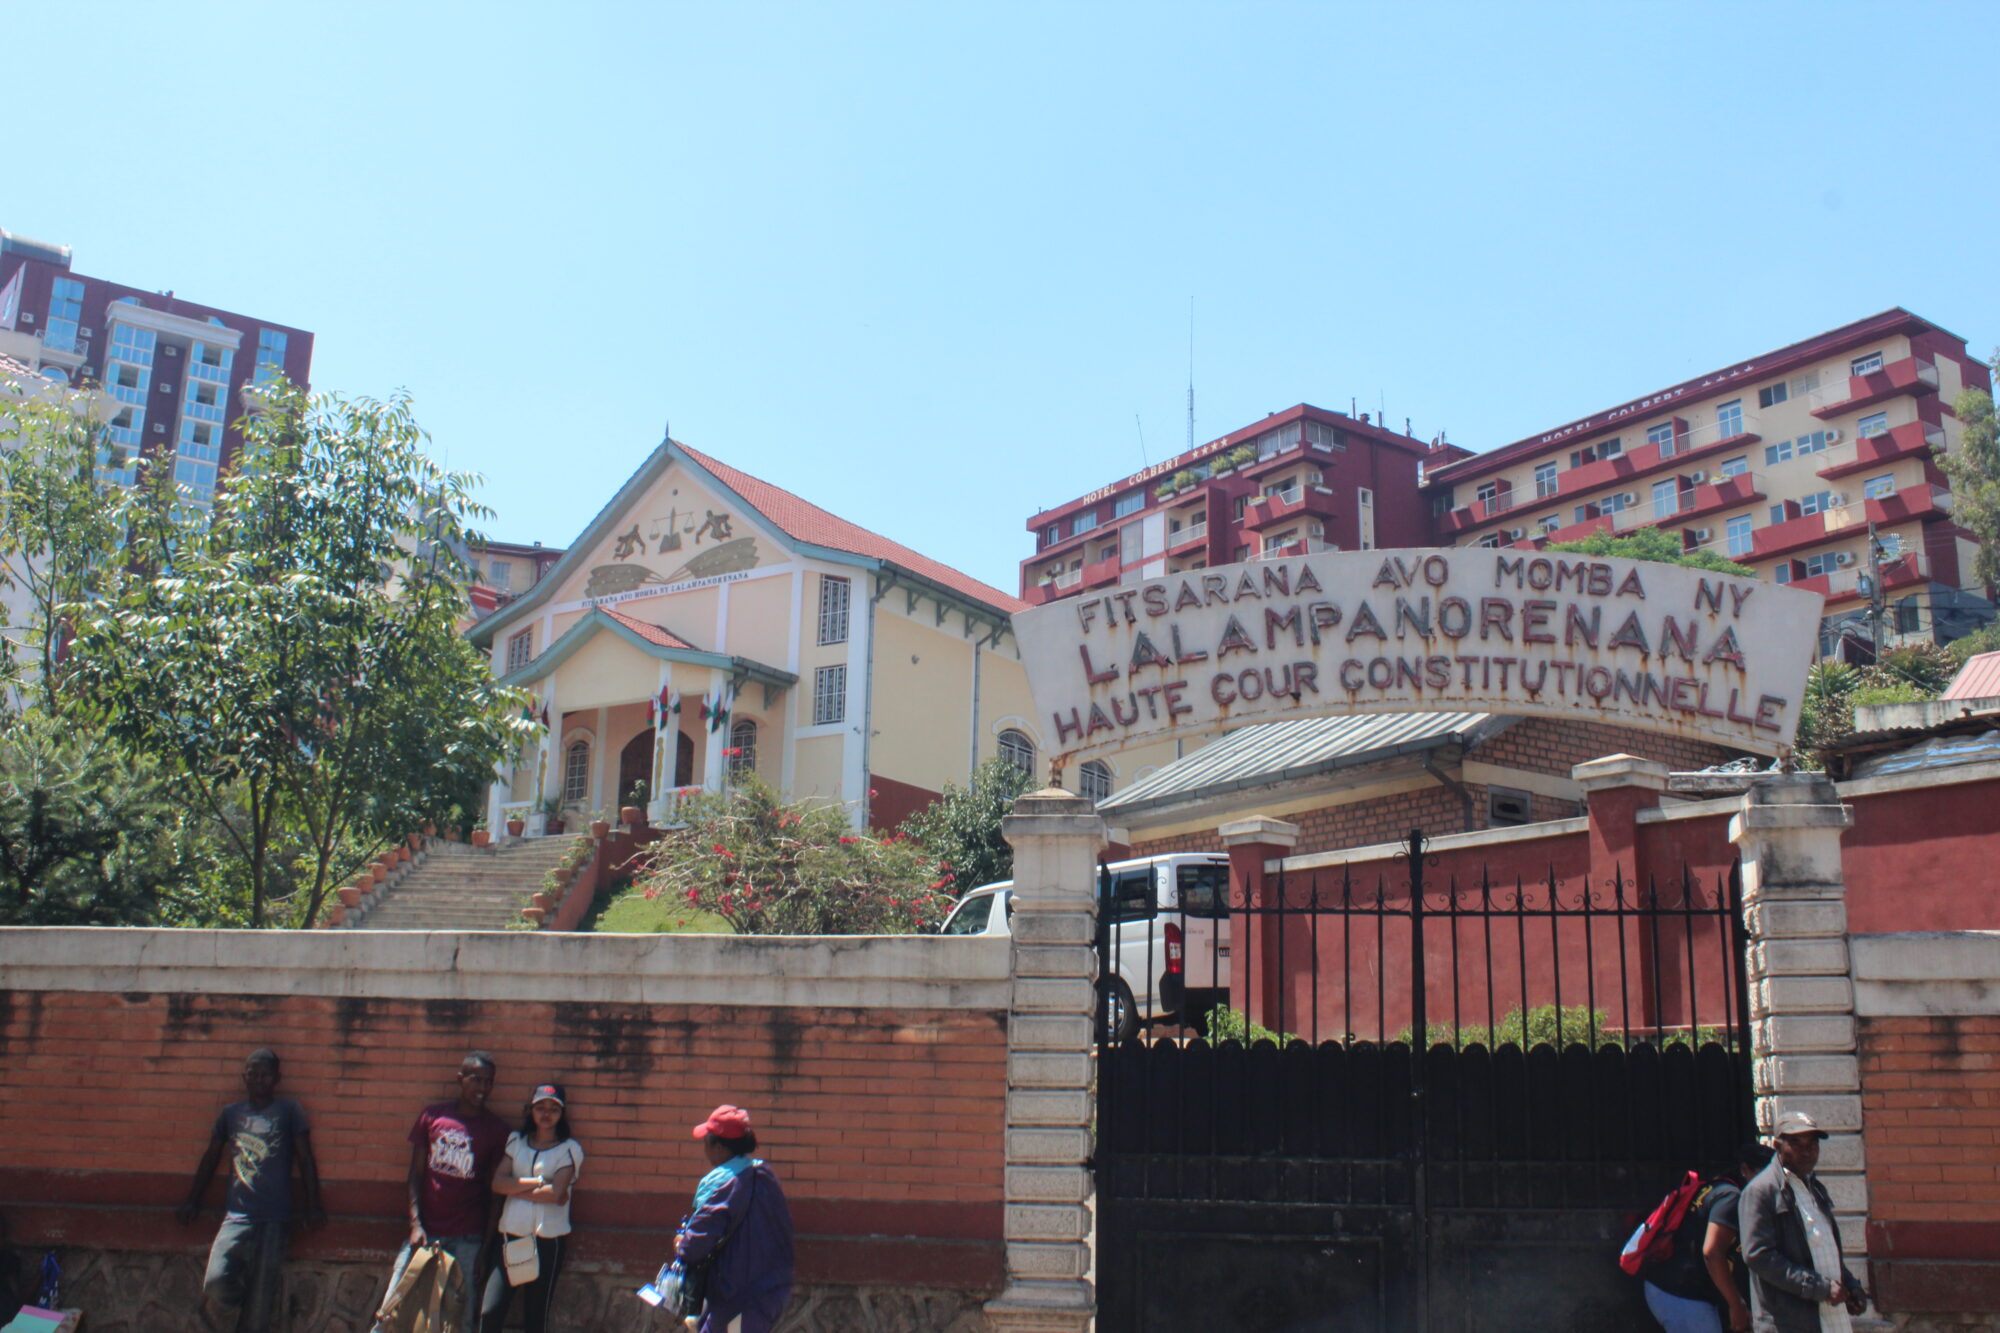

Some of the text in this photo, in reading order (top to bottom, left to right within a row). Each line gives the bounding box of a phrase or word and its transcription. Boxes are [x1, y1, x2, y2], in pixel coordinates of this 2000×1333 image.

[1083, 456, 1180, 506] HOTEL COLBERT
[582, 596, 618, 607] FITARANA
[1076, 554, 1754, 633] FITSARANA AVO MOMBA NY
[1079, 596, 1746, 686] LALAMPANORENANA
[1053, 655, 1787, 745] HAUTE COUR CONSTITUTIONNELLE
